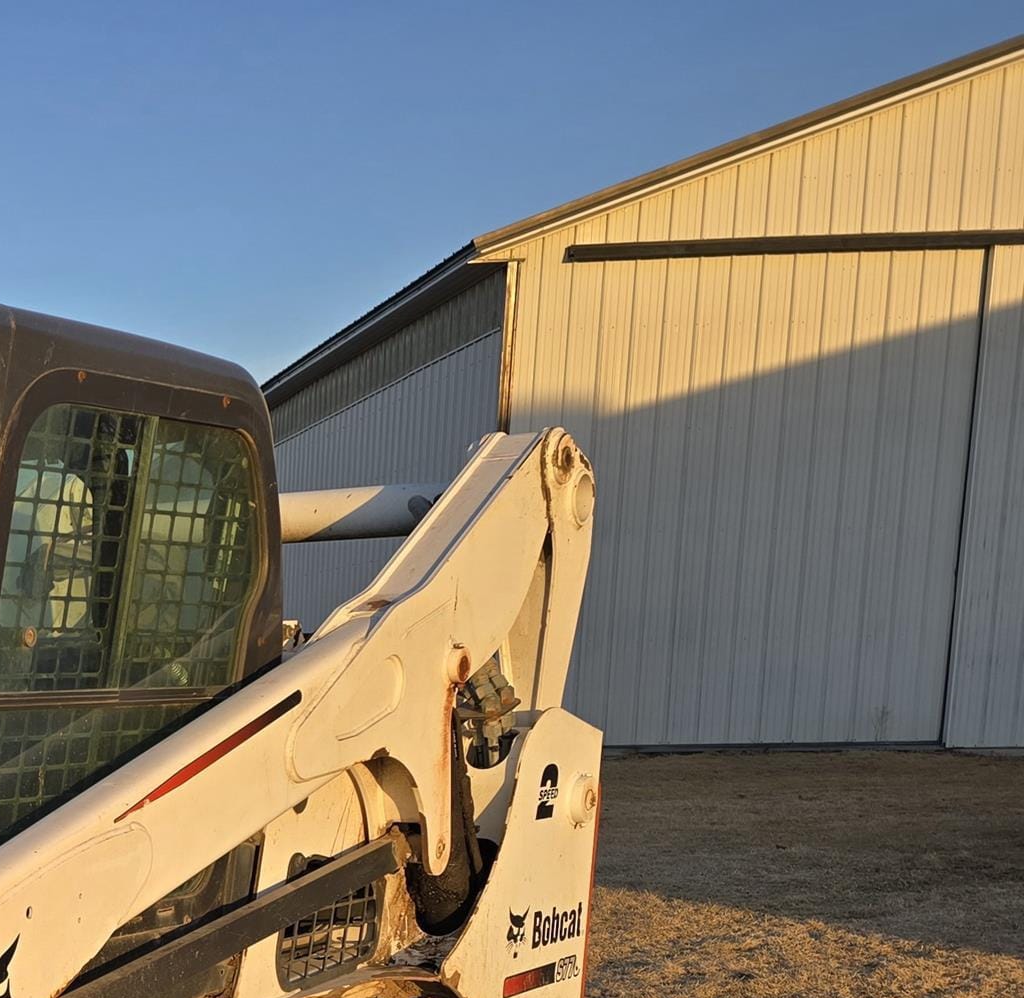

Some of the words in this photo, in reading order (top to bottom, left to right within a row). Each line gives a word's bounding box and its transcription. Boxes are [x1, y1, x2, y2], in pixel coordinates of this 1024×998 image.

[535, 763, 559, 820] 2
[538, 788, 559, 801] SPEED
[531, 901, 583, 950] Bobcat
